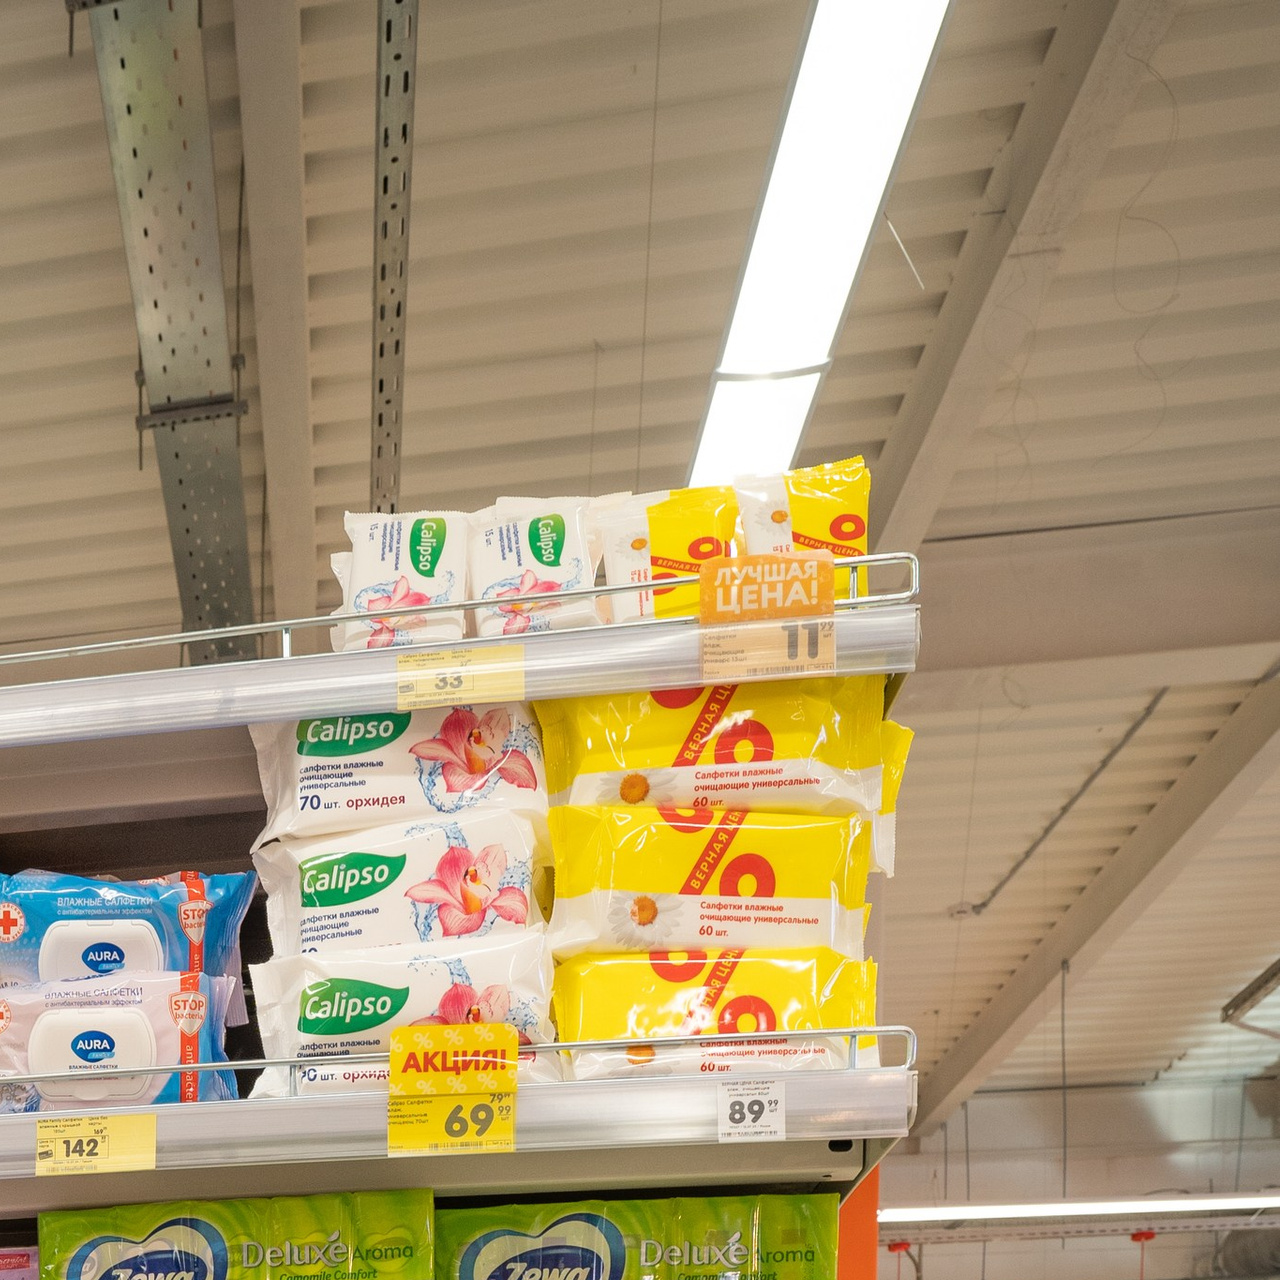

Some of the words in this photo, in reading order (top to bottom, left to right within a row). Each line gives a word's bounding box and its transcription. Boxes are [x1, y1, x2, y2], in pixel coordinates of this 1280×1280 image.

[417, 522, 436, 570] Calipso
[537, 519, 556, 561] Calipso
[799, 536, 833, 551] ВЕРНАЯ
[835, 546, 858, 557] ЦЕНА
[715, 561, 818, 585] ЛУЧШАЯ
[717, 581, 818, 614] ЦЕНА!
[781, 621, 819, 660] 11
[435, 672, 463, 690] 33
[307, 717, 394, 744] Calipso
[300, 763, 341, 775] салфетки
[344, 760, 384, 769] влажные
[300, 770, 353, 783] очищающие
[300, 779, 366, 792] универсальные
[299, 795, 320, 811] 70
[324, 800, 341, 809] шт.
[346, 794, 405, 809] орхидея
[303, 866, 390, 893] Calipso
[58, 896, 102, 906] ВЛАЖНЫЕ
[104, 896, 153, 906] САЛФЕТКИ
[700, 902, 741, 913] Салфетки
[745, 902, 783, 912] влажные
[700, 913, 750, 924] очищающие
[754, 915, 819, 925] универсальные
[699, 925, 713, 937] 60
[716, 927, 728, 937] шт.
[174, 1000, 205, 1011] STOP
[305, 997, 392, 1025] Calipso
[175, 1009, 204, 1021] bacteria
[77, 1040, 110, 1050] AURA
[401, 1049, 506, 1074] АКЦИЯ!
[444, 1104, 495, 1136] 69
[497, 1106, 510, 1115] 99
[728, 1099, 765, 1124] 89
[767, 1099, 778, 1107] 99
[62, 1139, 98, 1157] 142
